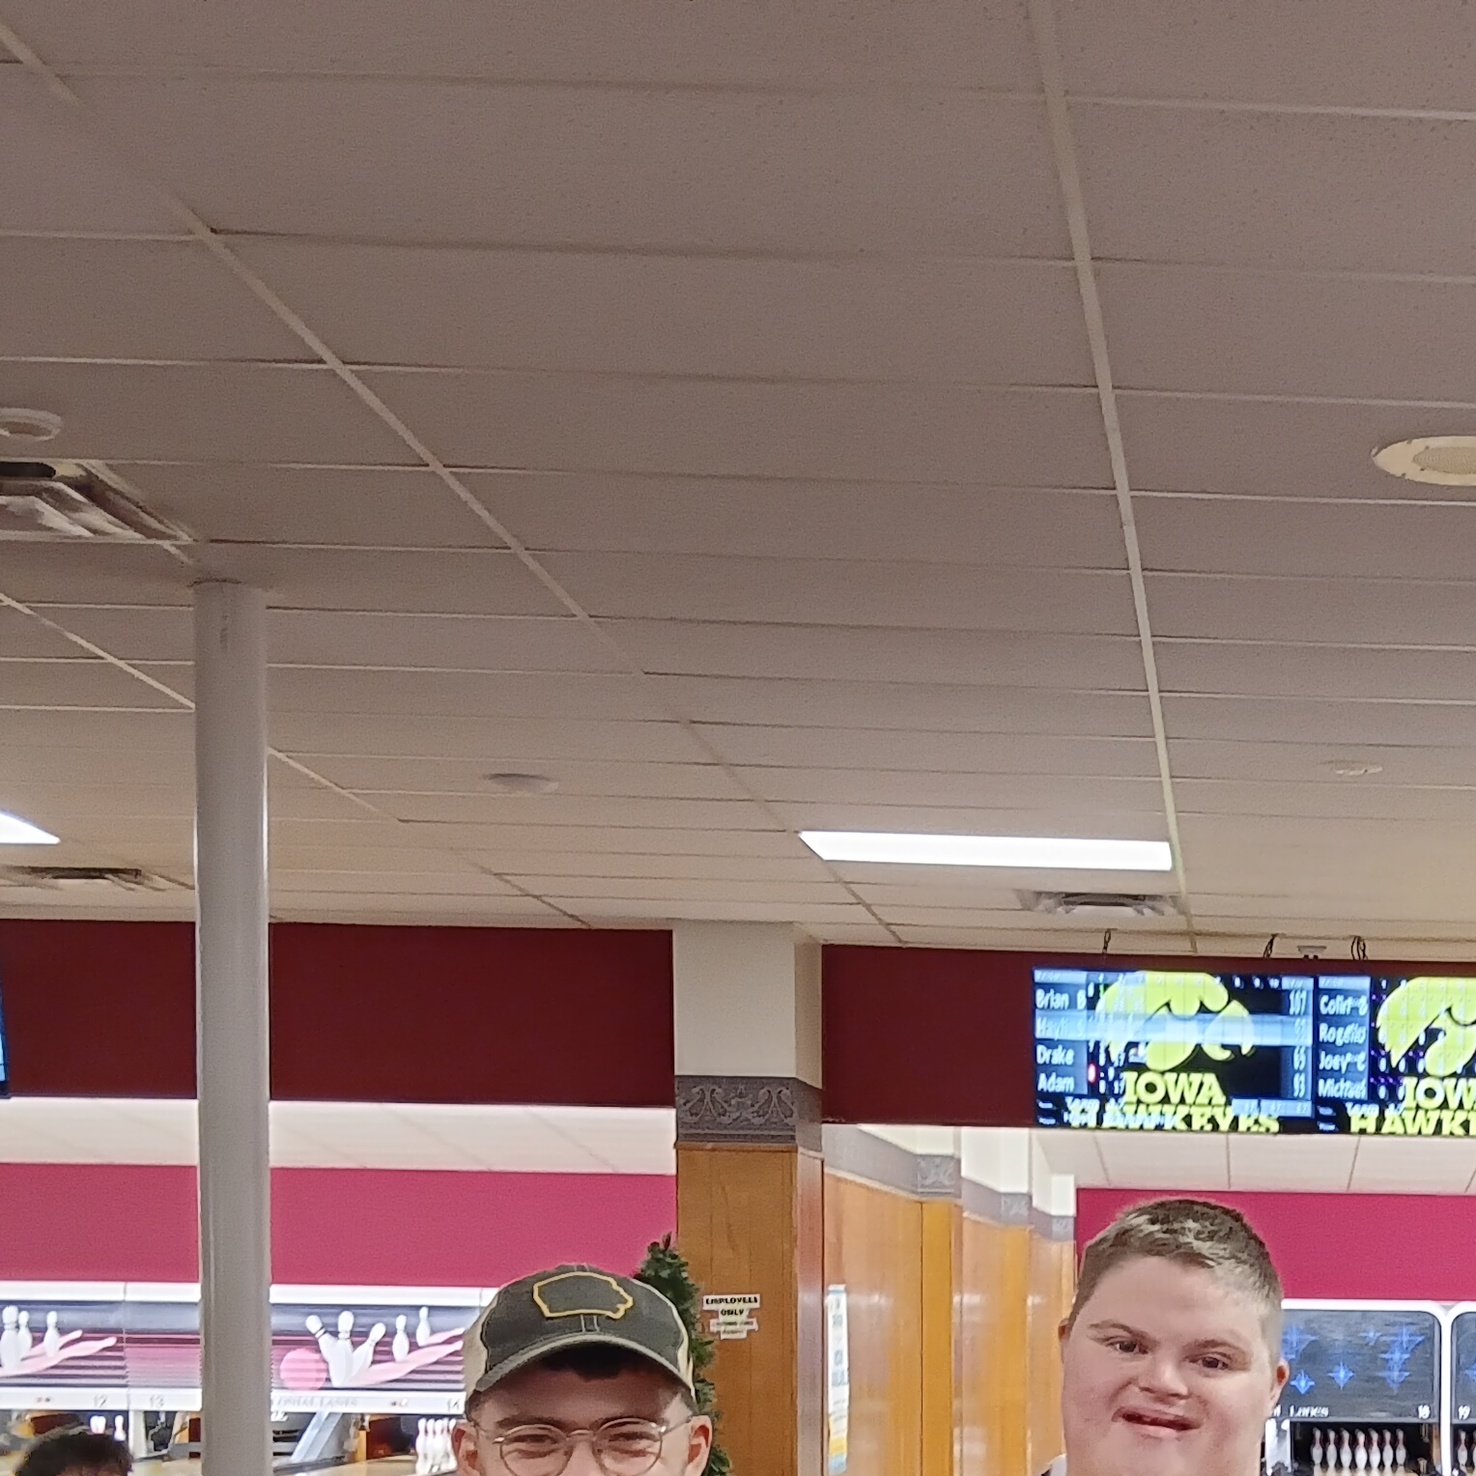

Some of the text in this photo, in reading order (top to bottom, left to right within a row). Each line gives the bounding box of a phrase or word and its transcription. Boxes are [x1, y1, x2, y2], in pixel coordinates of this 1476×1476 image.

[1036, 989, 1069, 1010] Brian
[1036, 1044, 1075, 1064] Drake
[1037, 1072, 1075, 1092] Adam
[1122, 1071, 1226, 1105] IOWA
